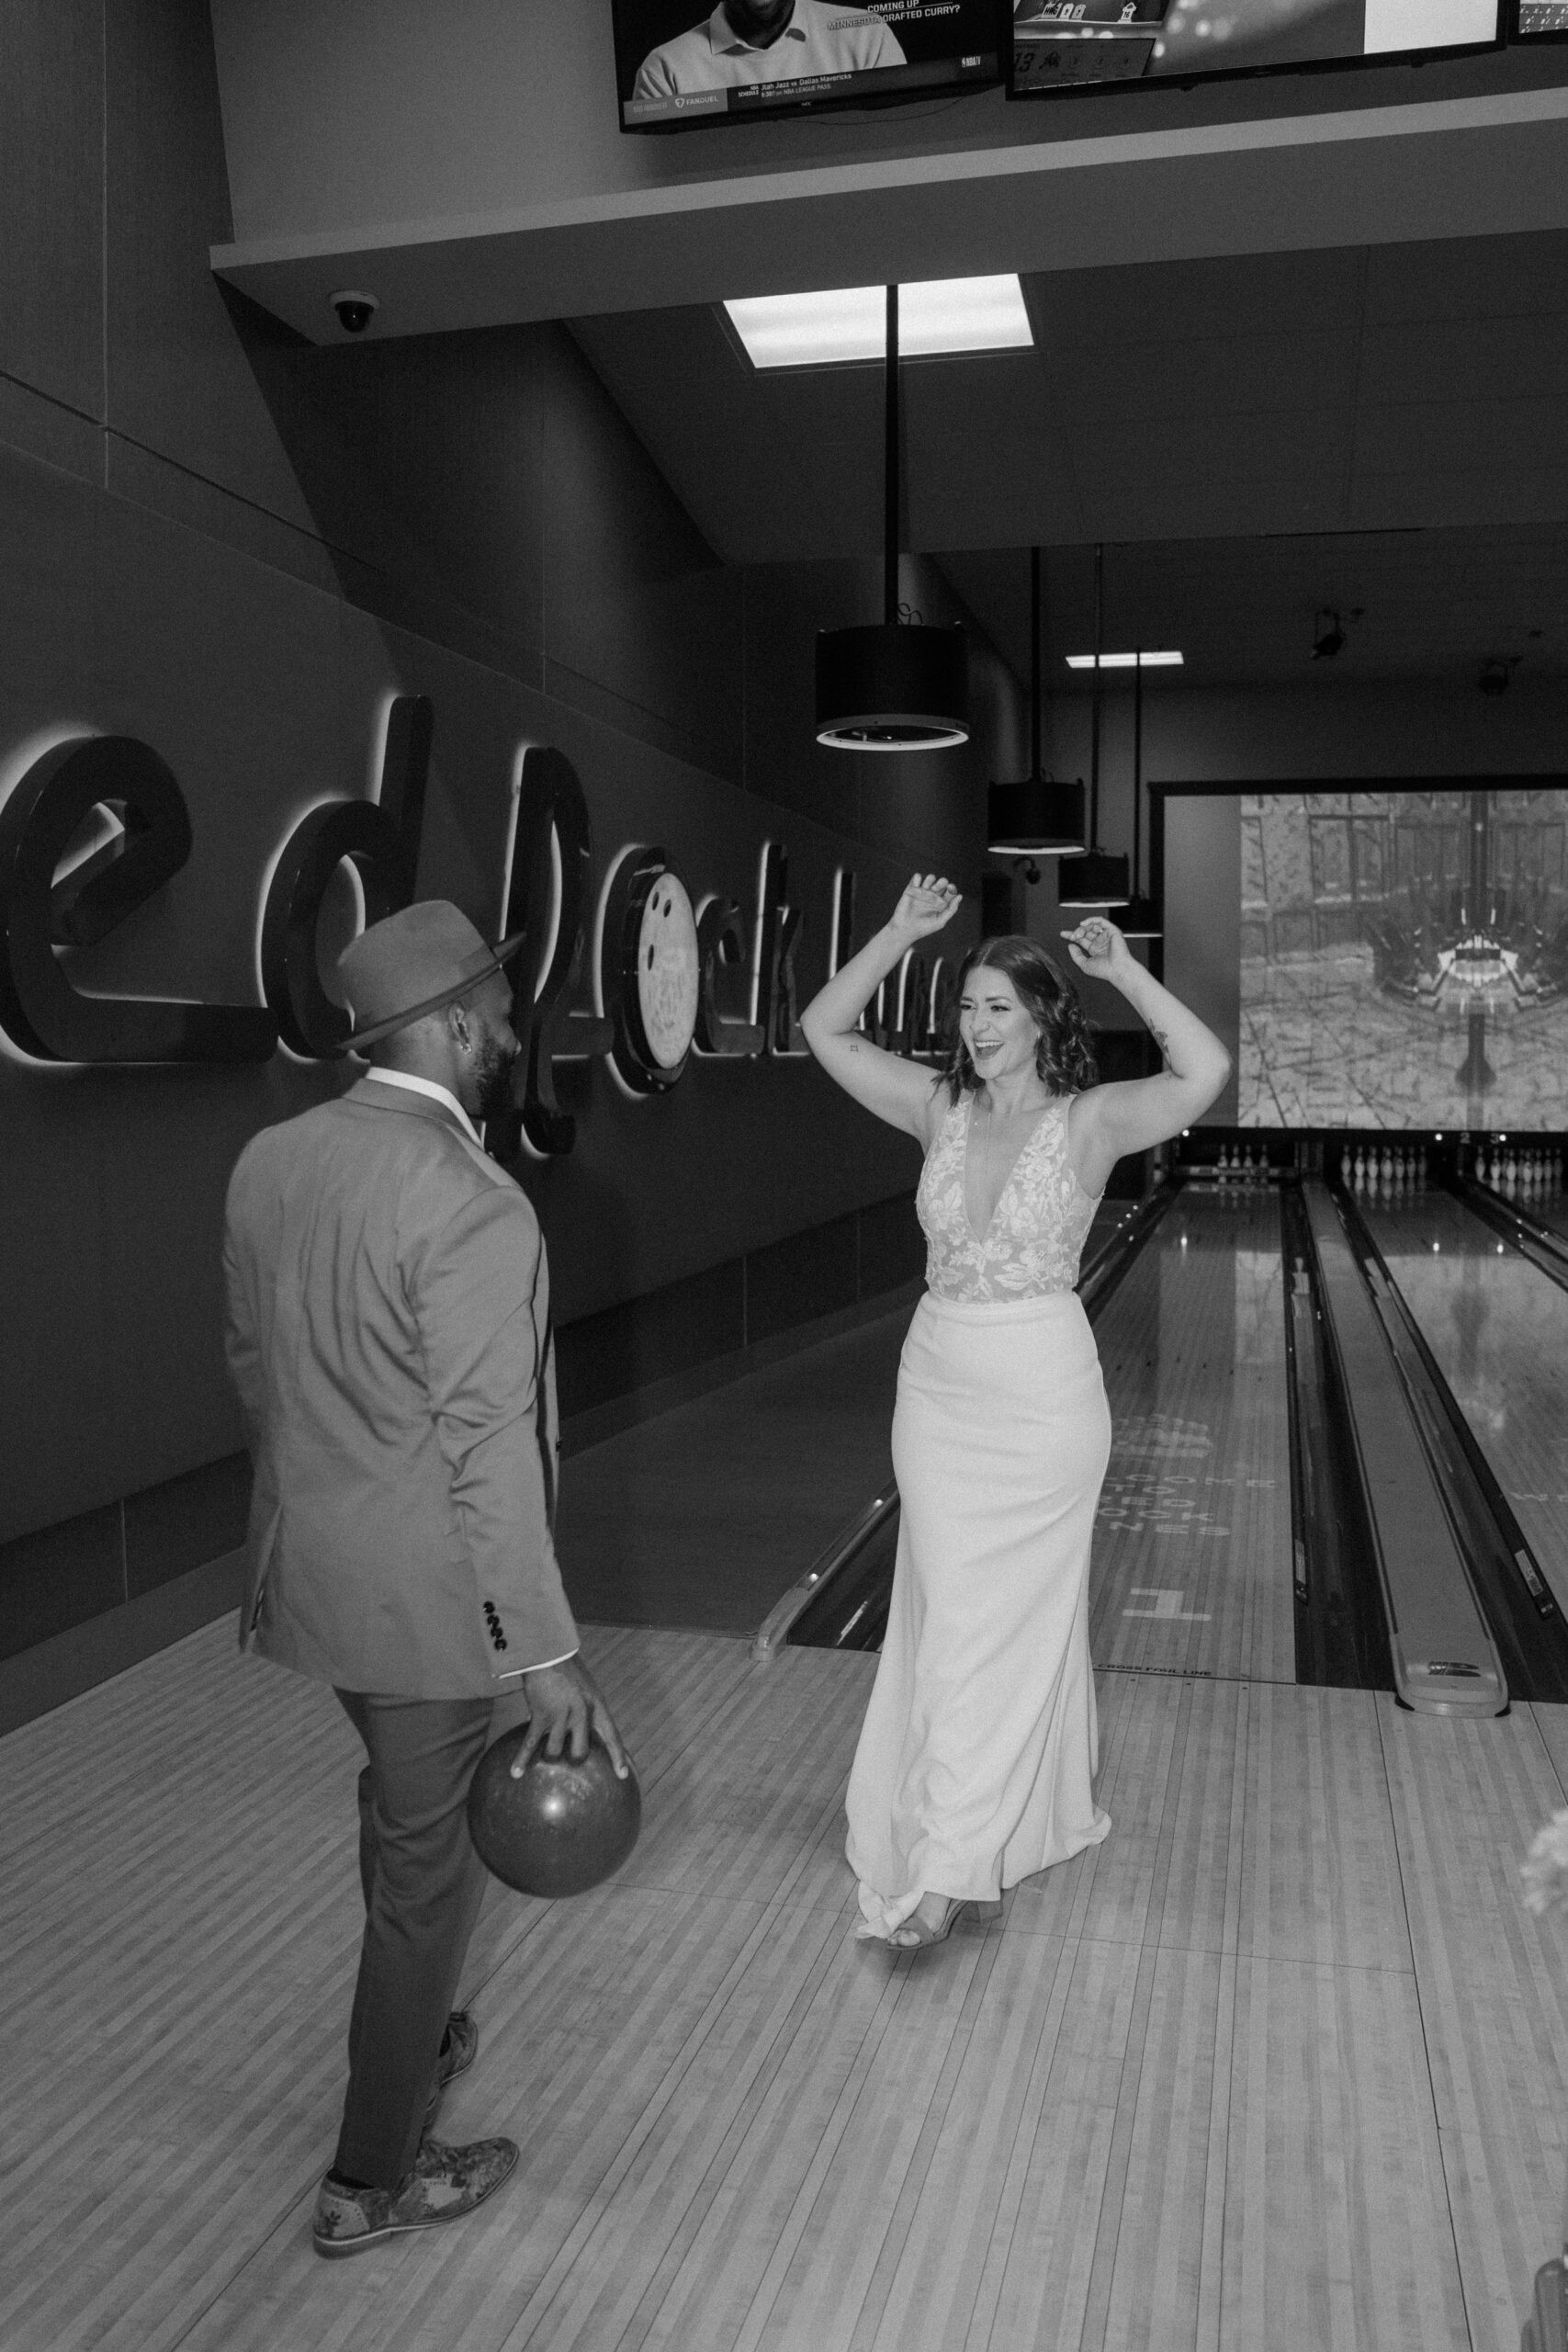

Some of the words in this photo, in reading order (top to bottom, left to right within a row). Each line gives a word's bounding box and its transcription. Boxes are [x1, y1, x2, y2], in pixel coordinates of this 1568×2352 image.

[867, 0, 905, 14] COMING
[907, 0, 919, 9] UP
[828, 17, 882, 30] MINNESOTA
[883, 9, 923, 23] DRAFTED
[924, 5, 961, 17] CURRY?
[799, 77, 818, 86] Dallas
[820, 74, 852, 83] Mavericks
[686, 96, 718, 106] FANDUEL
[1096, 1521, 1230, 1536] NES
